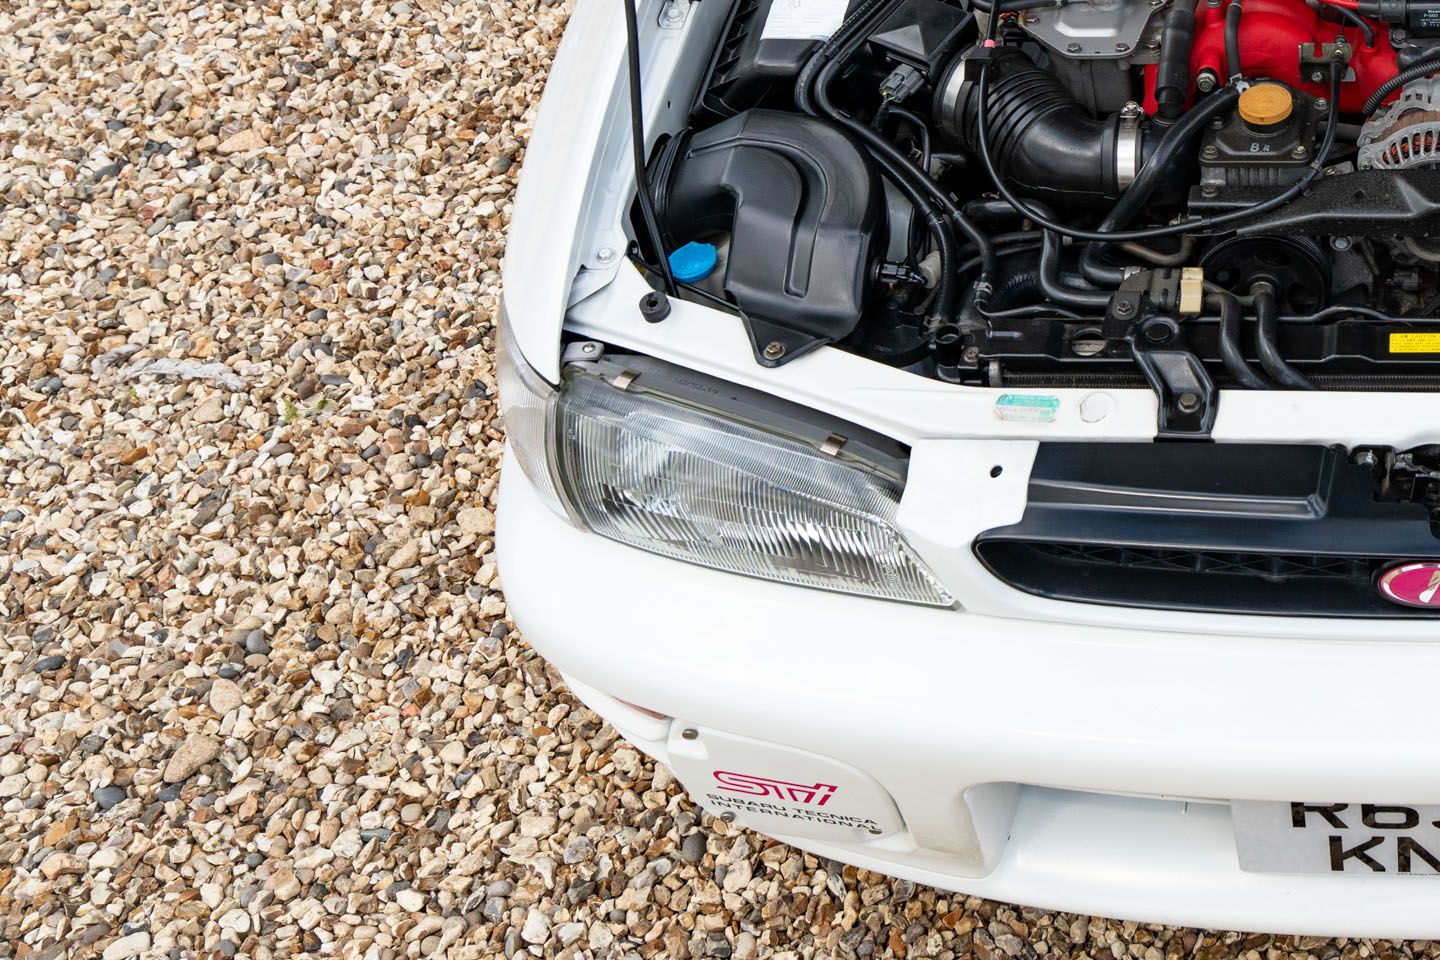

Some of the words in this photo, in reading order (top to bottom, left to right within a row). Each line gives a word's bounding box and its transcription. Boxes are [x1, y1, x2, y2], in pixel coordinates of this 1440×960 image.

[706, 793, 787, 811] SUBARU
[792, 808, 878, 825] TECNICA
[710, 800, 882, 832] INTERNATIONAL
